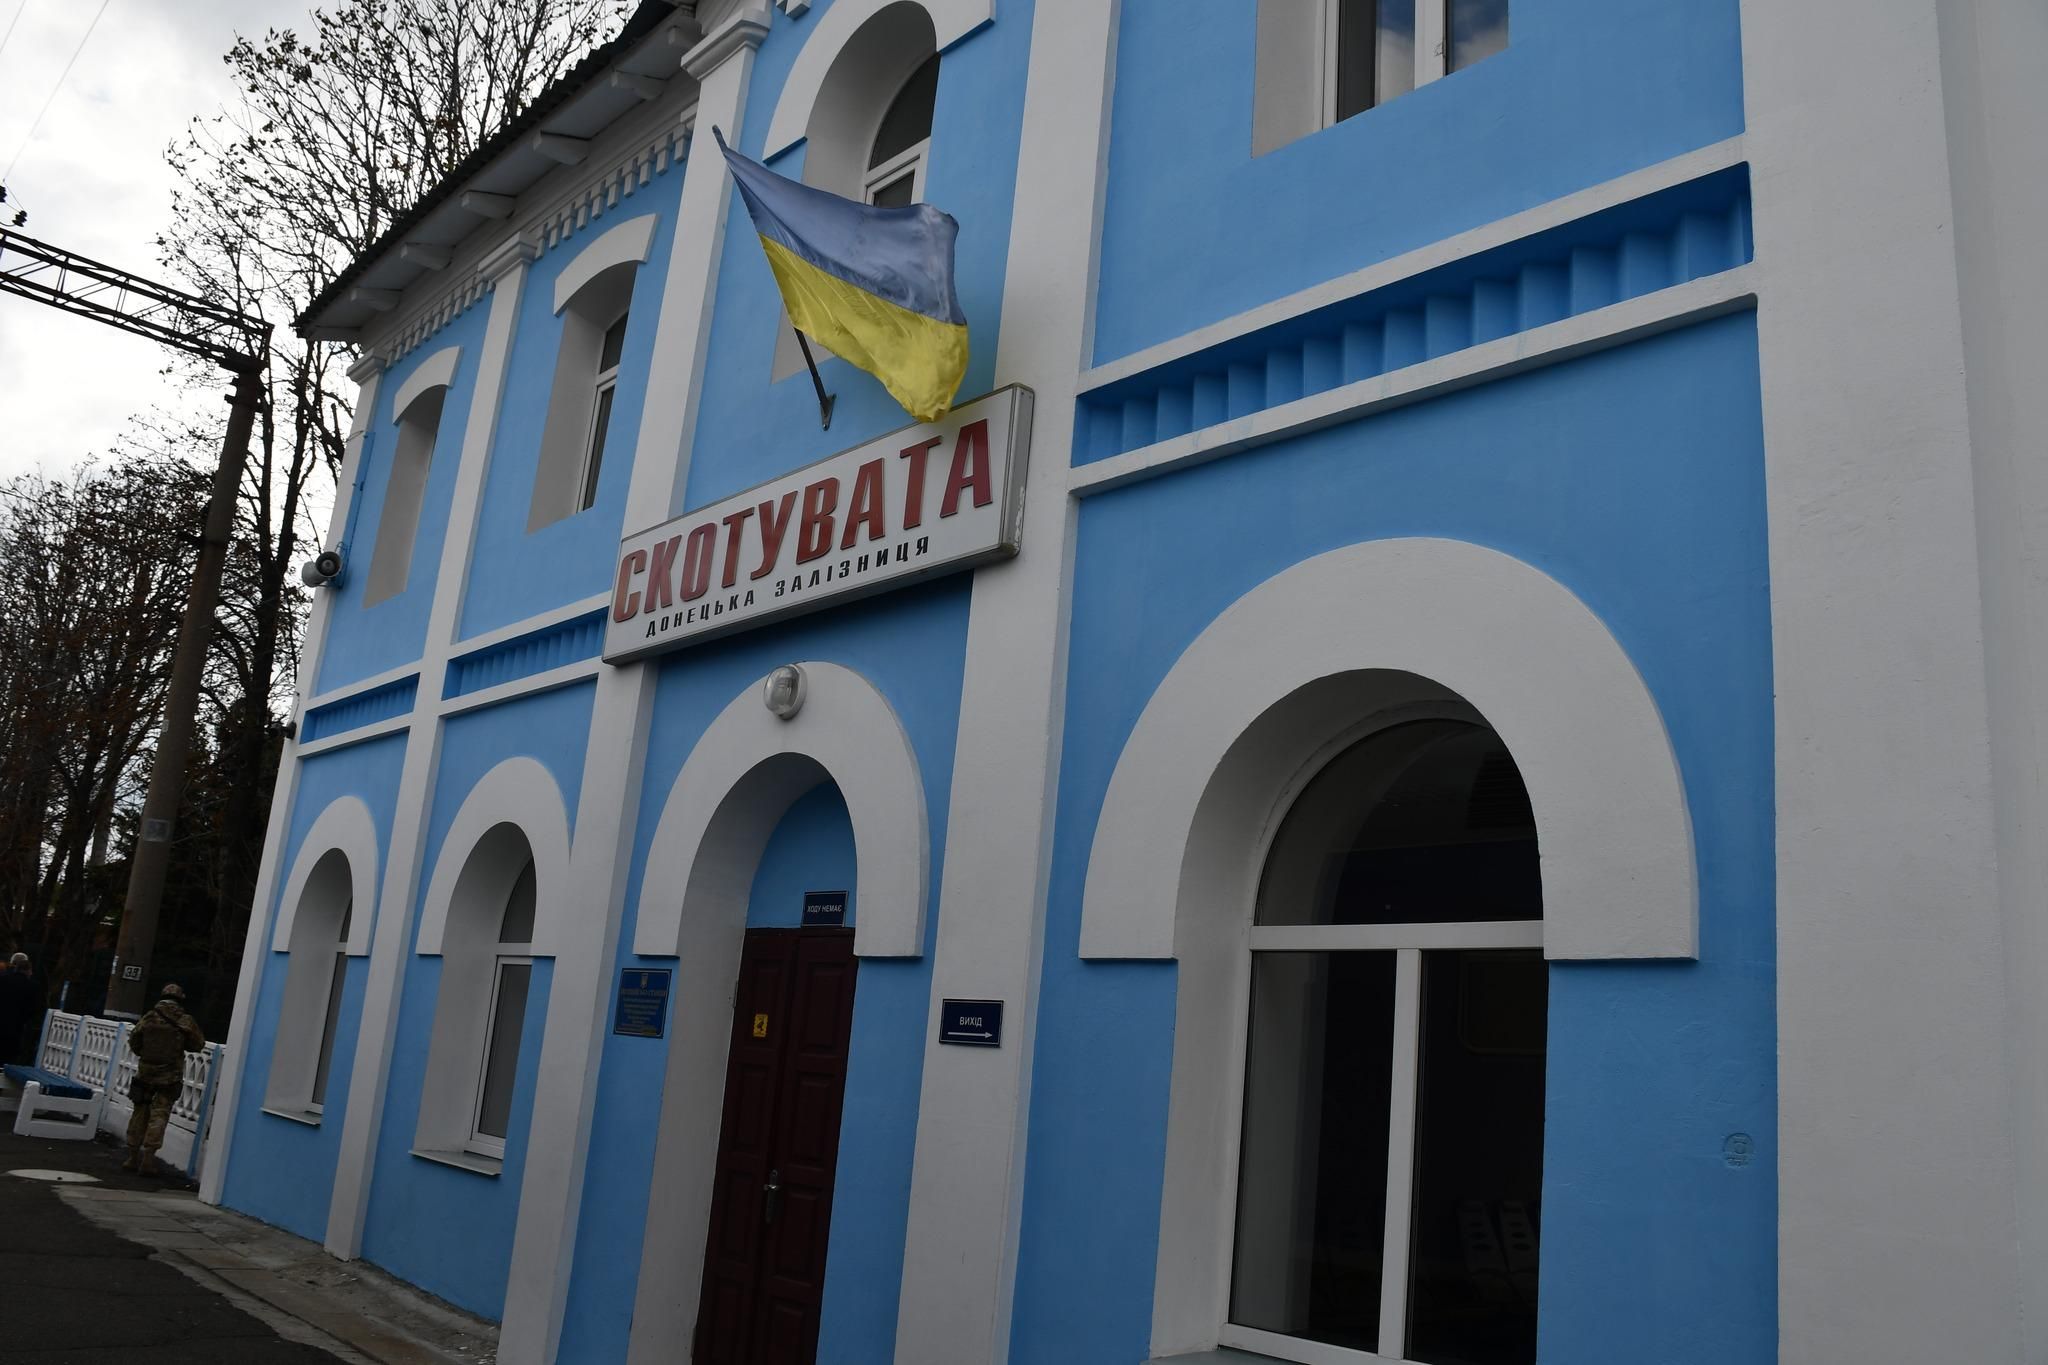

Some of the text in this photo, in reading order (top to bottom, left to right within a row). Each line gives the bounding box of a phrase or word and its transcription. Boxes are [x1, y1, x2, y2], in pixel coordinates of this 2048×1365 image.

[613, 418, 992, 624] СКОТУВАТА
[646, 535, 931, 639] ДОНЕЦЬКА ЗАЛІЗНИЦЯ
[959, 1016, 983, 1028] ВИХІД
